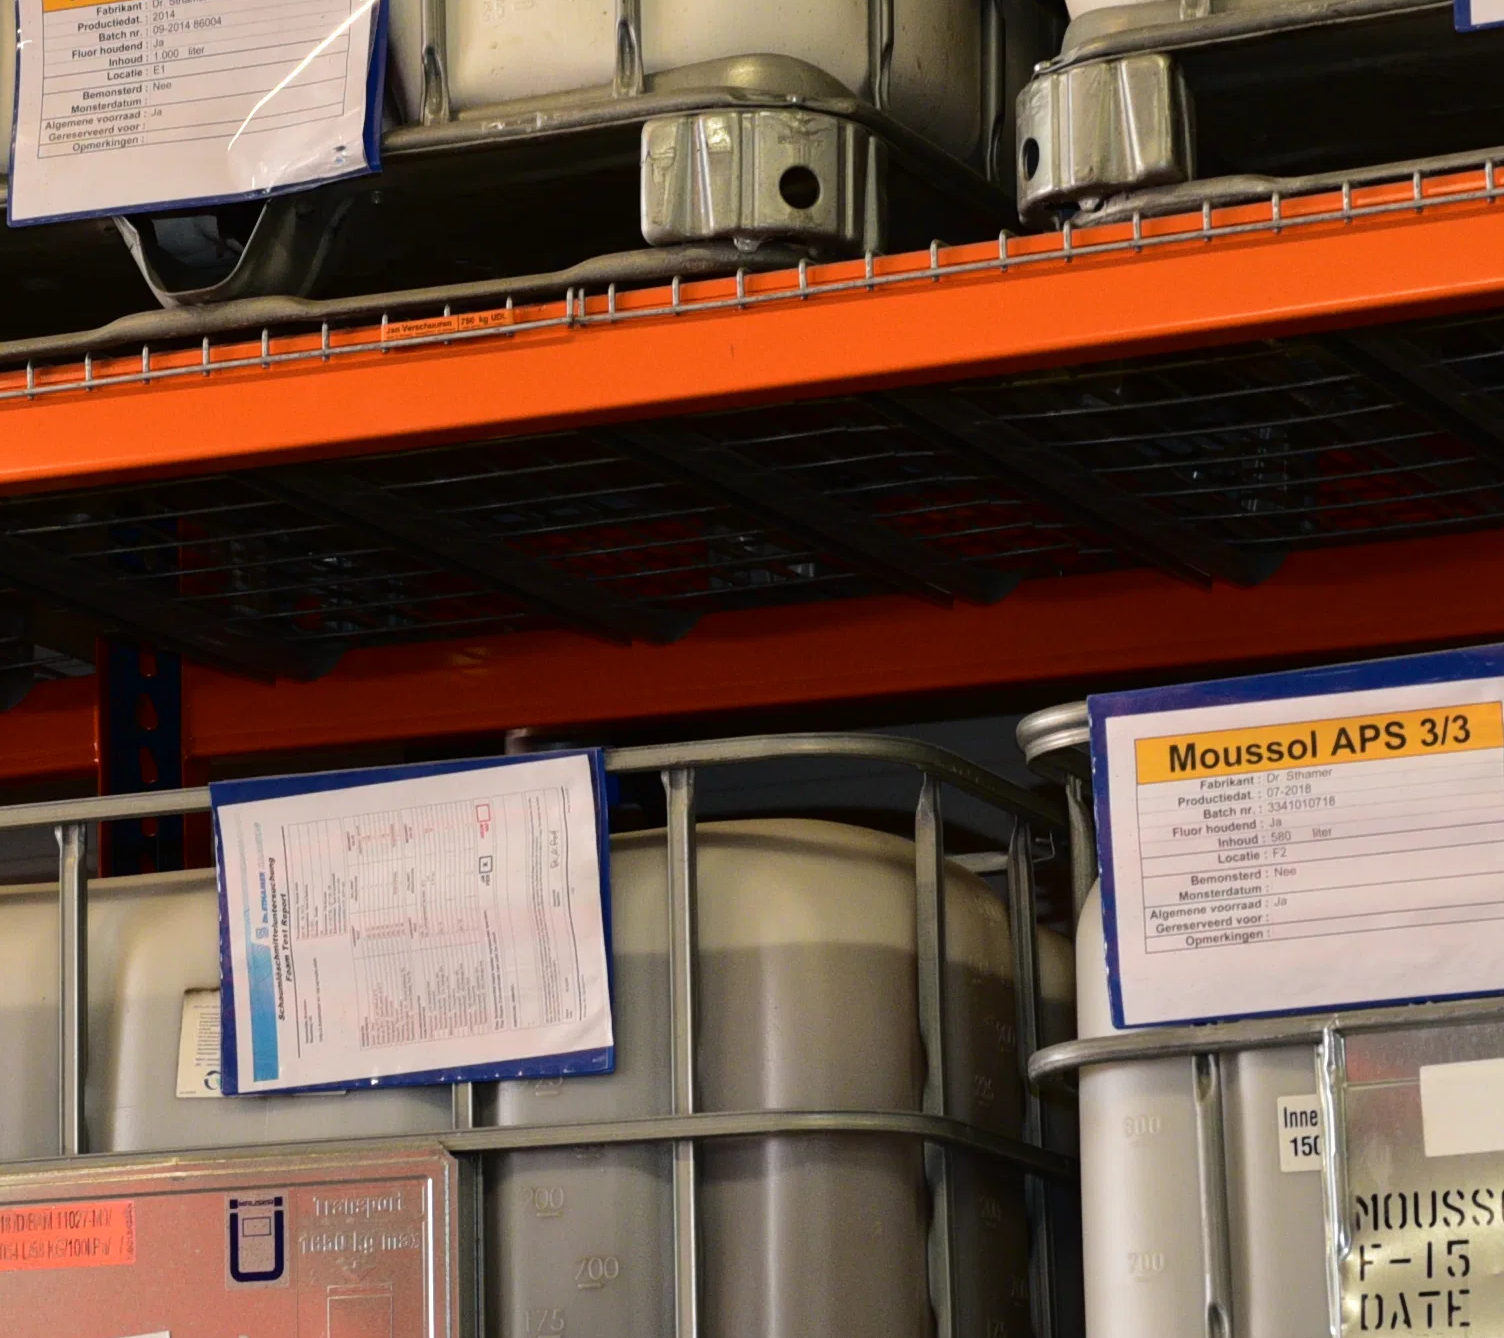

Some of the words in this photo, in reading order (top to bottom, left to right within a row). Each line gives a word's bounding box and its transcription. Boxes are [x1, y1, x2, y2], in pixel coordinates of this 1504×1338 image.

[96, 0, 143, 16] Fabrikant
[77, 14, 143, 32] Productiedat.
[152, 10, 176, 21] 2014
[99, 30, 125, 43] Batch
[129, 29, 143, 38] nr.
[152, 21, 191, 35] 09-2014
[193, 17, 222, 29] 86004
[108, 54, 143, 67] Inhoud
[154, 48, 179, 60] 1.000
[188, 45, 205, 56] liter
[106, 67, 143, 81] Locatie
[153, 65, 166, 75] E1
[82, 84, 143, 101] Bemonsterd
[153, 80, 172, 91] Nee
[71, 97, 142, 113] Monsterdatum
[72, 135, 139, 153] Opmerkingen
[1169, 730, 1318, 774] Moussol
[1331, 721, 1408, 757] APS
[1420, 714, 1472, 747] 3/3
[1359, 1238, 1471, 1282] F-15
[1360, 1286, 1471, 1331] DATE
